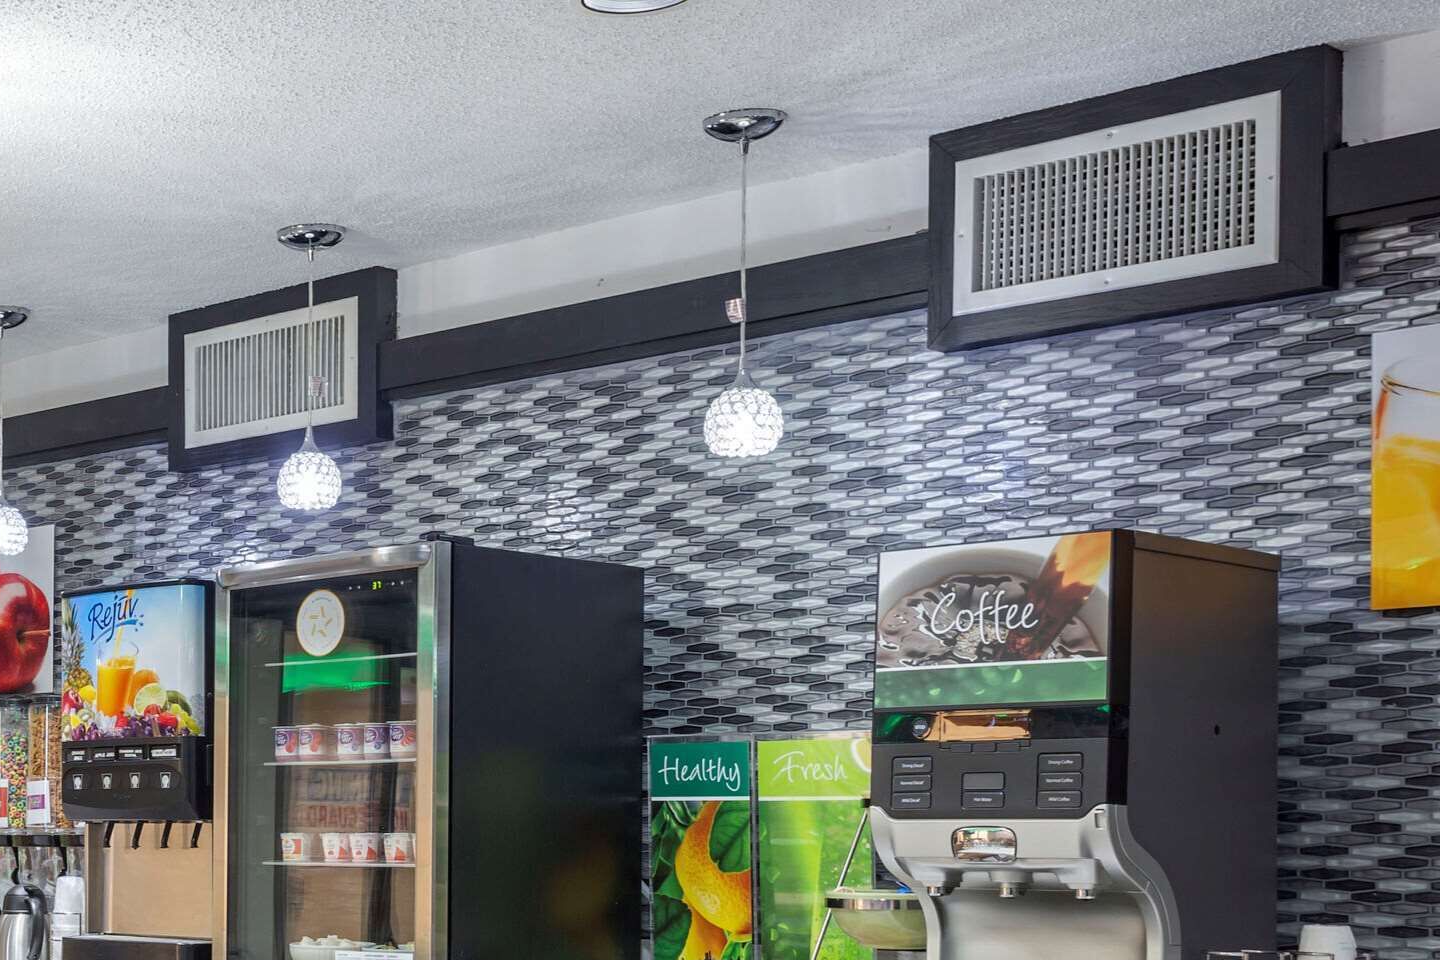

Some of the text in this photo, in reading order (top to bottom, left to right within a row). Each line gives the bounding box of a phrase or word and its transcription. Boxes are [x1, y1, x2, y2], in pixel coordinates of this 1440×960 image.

[931, 590, 1039, 645] Coffee
[657, 755, 741, 792] Healthy
[770, 751, 848, 784] Fresh
